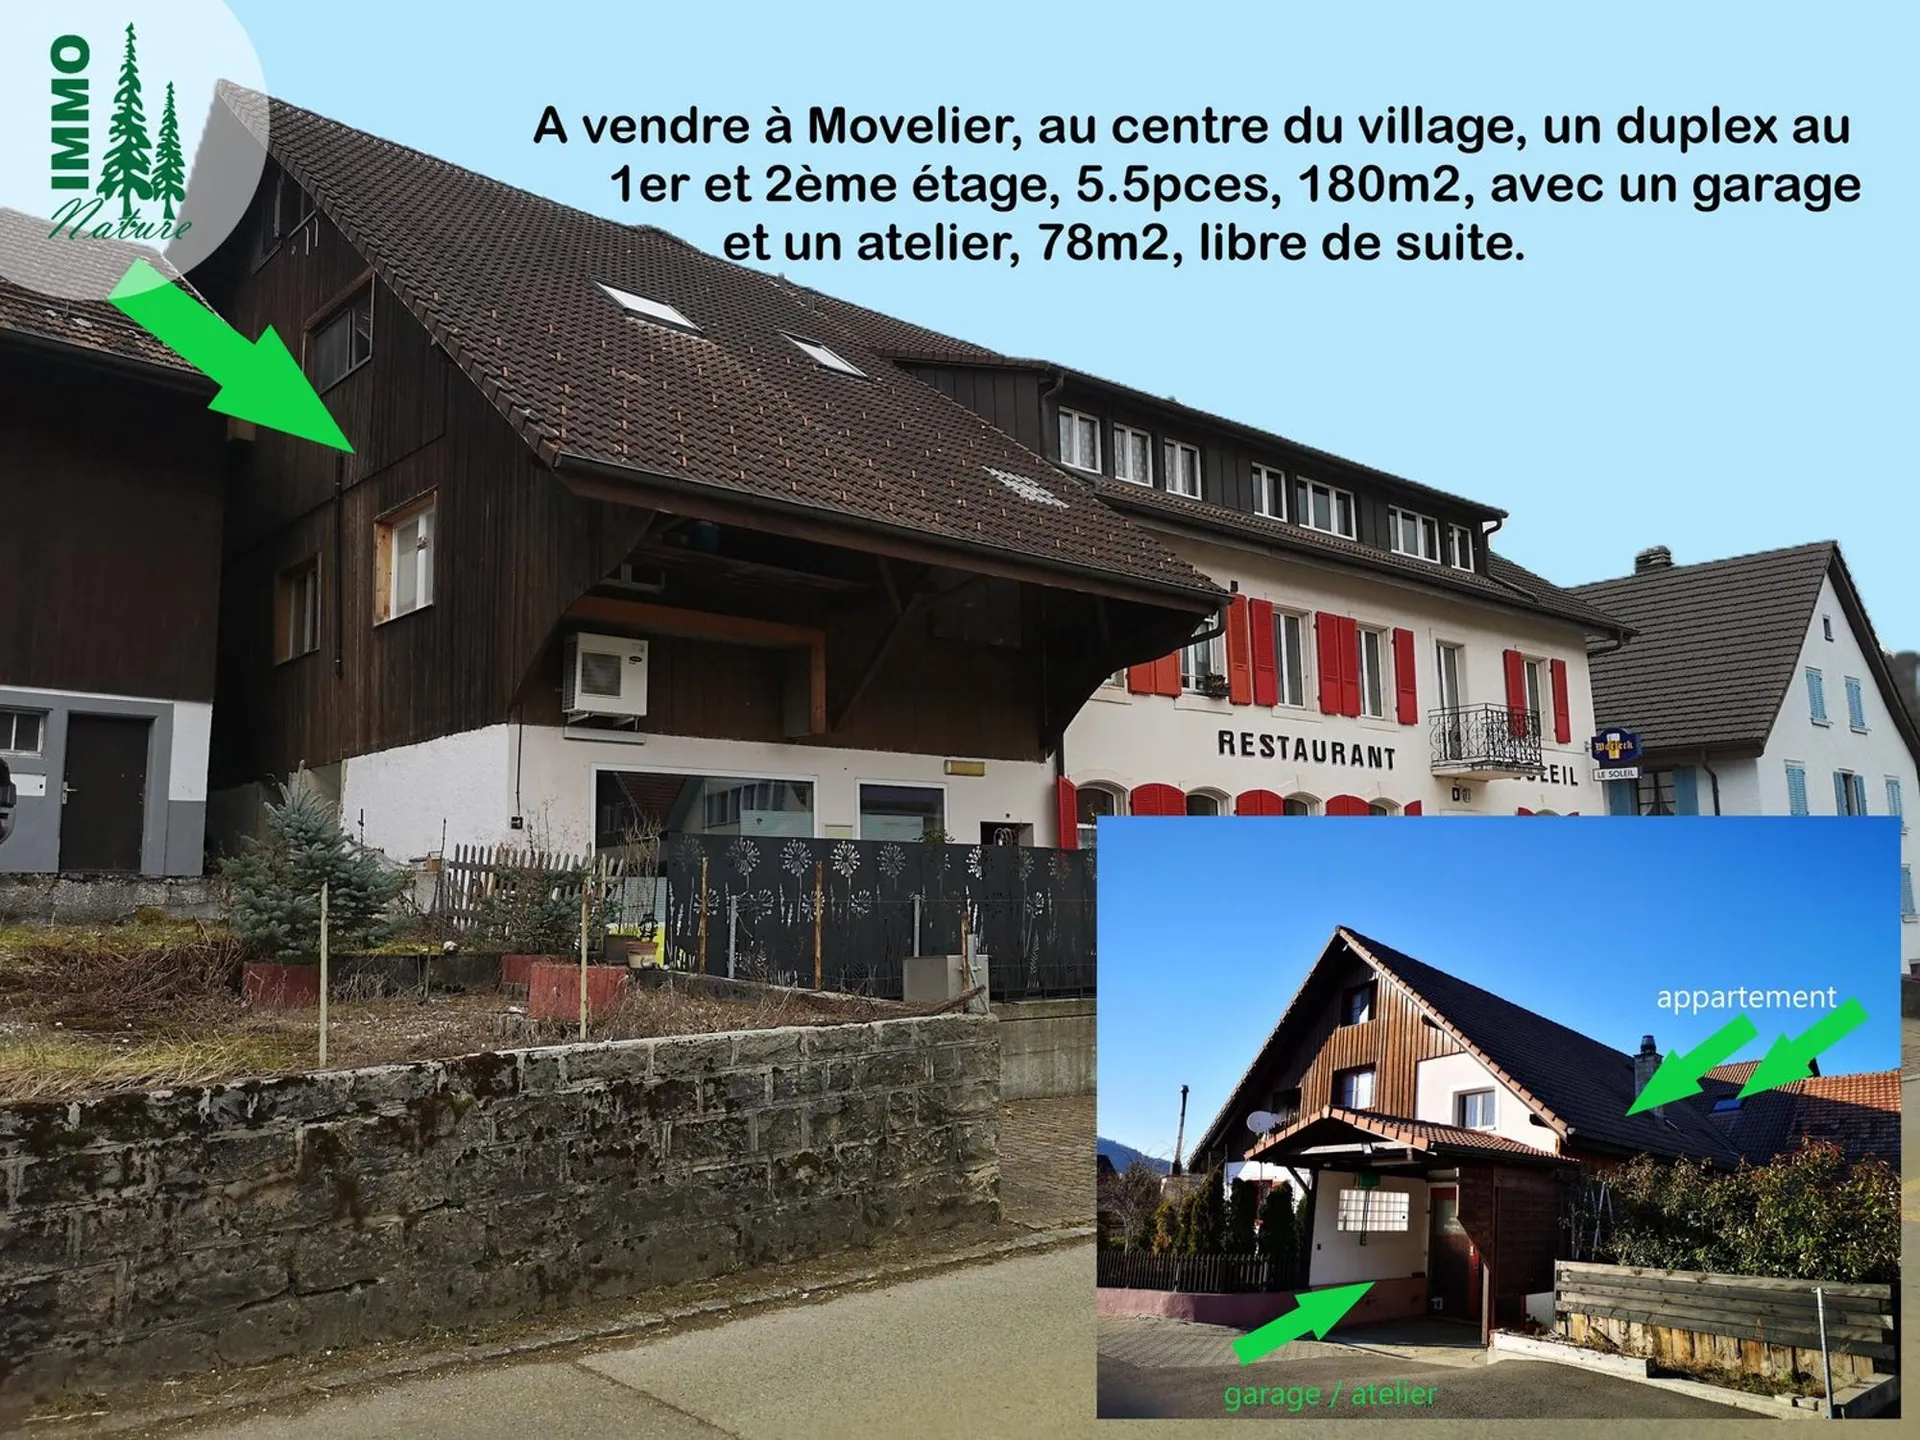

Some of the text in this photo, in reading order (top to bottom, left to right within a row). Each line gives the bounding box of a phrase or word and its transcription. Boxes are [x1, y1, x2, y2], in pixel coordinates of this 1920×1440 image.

[1217, 729, 1579, 787] RESTAURANT LEIL
[1597, 769, 1635, 779] LE SOLEIL
